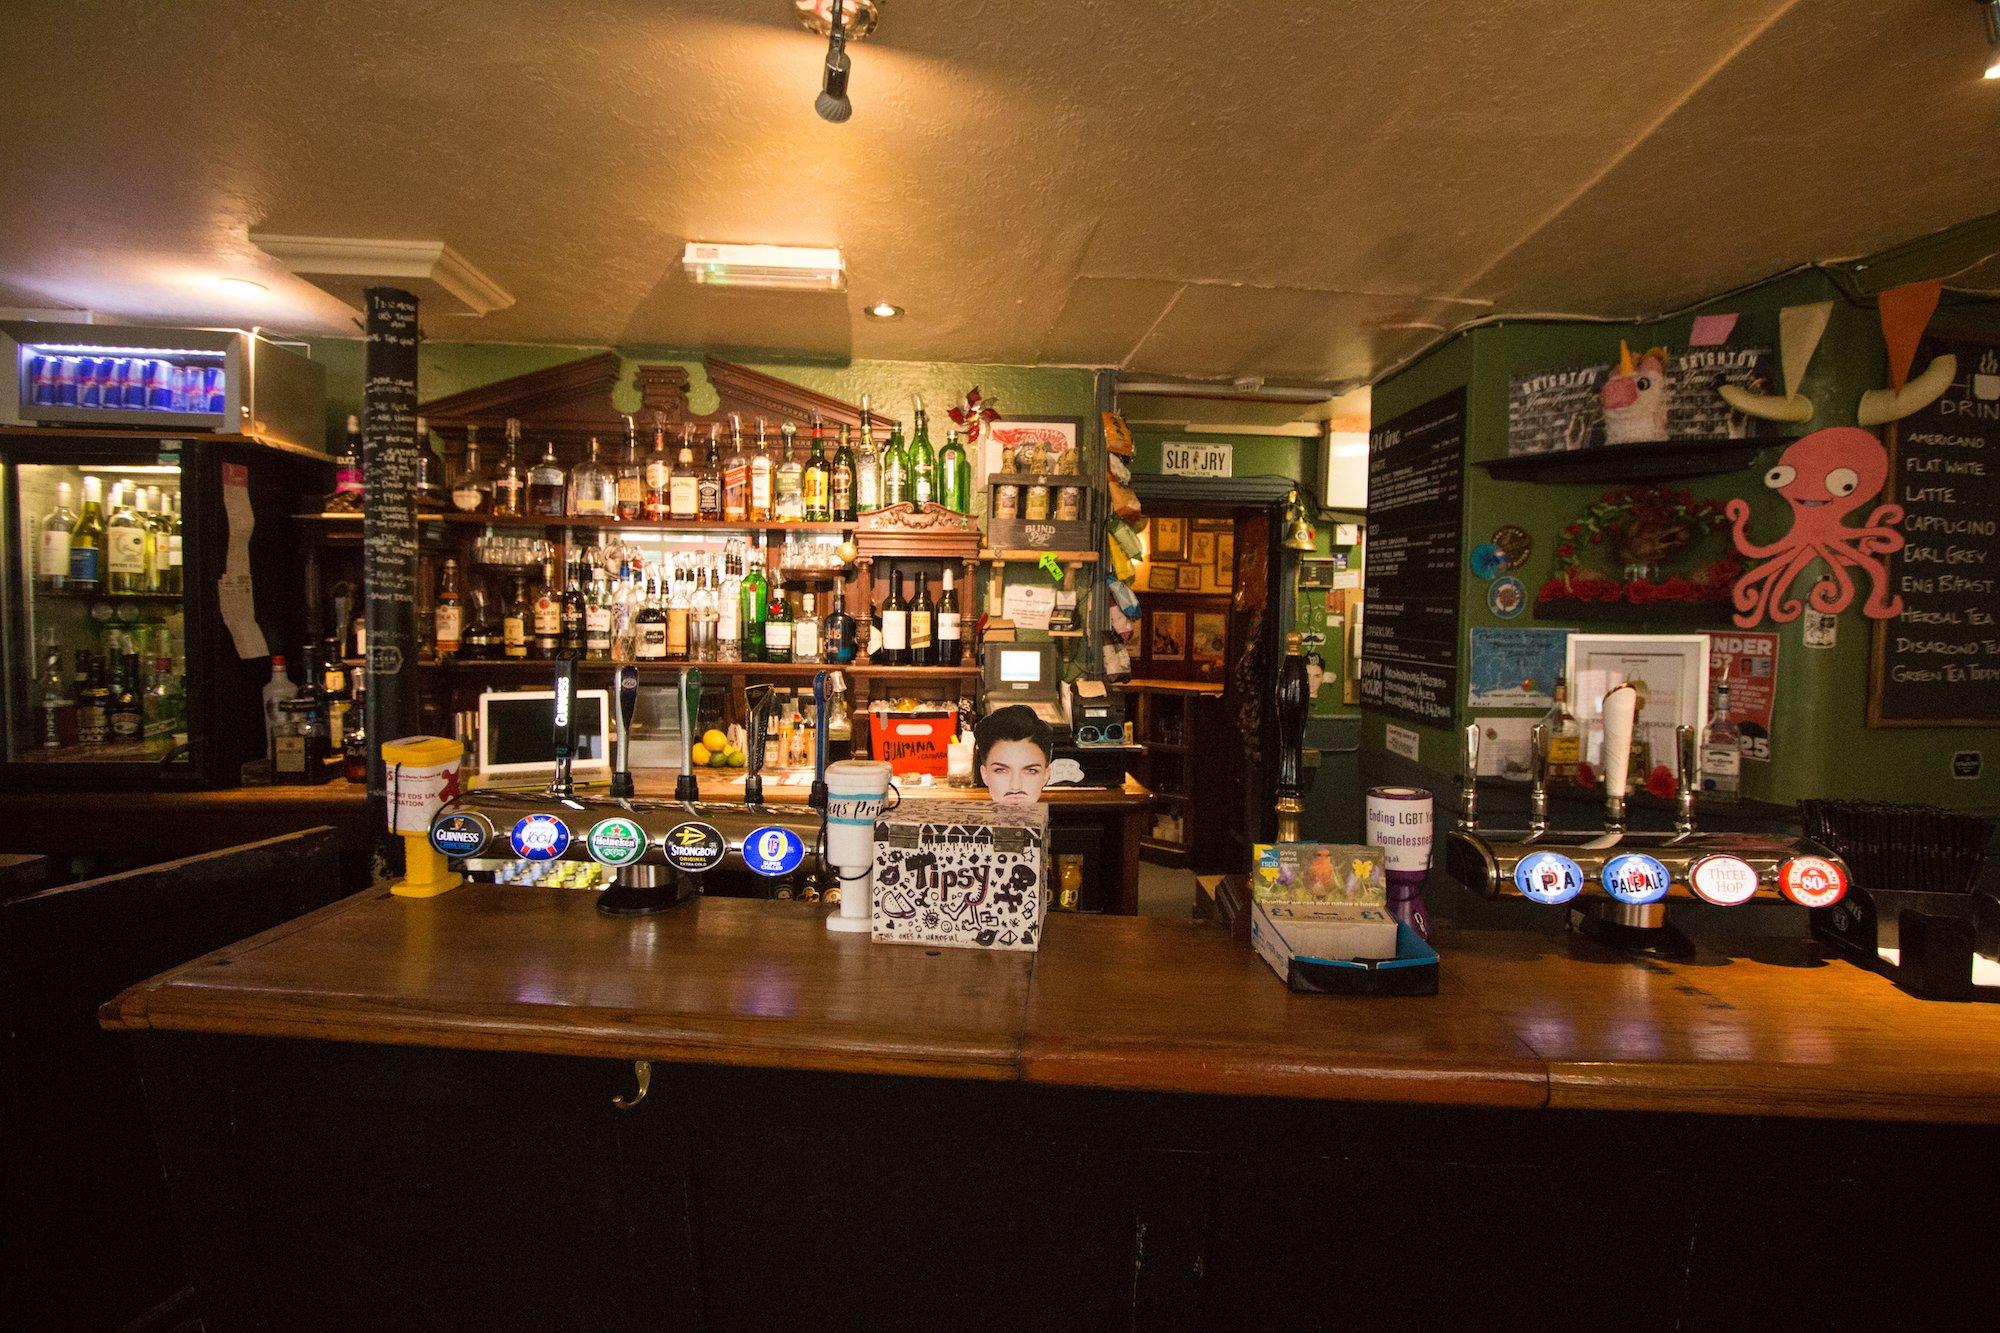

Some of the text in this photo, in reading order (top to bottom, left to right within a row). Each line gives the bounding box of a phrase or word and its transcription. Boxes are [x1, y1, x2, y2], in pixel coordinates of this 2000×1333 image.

[1679, 352, 1758, 370] BRIGHTON
[1522, 371, 1598, 395] BRIGHTON
[1940, 400, 2000, 420] DRIN
[1908, 432, 1985, 449] AMERICANO
[1166, 450, 1225, 470] SLR JRY
[1906, 457, 1986, 476] FLAT WHITE
[1904, 485, 1957, 503] LATTE
[1904, 514, 1997, 536] CAPPUCINO
[1903, 543, 1988, 564] EARL GREY
[1901, 576, 1934, 593] ENG
[1900, 606, 1995, 625] HERBAL TEA
[1712, 637, 1773, 656] NDER
[1890, 664, 1943, 683] GREEN
[1942, 663, 1966, 682] TEA
[1740, 738, 1769, 758] 25
[1369, 808, 1395, 826] Ending
[1399, 812, 1423, 825] LGBT
[436, 829, 479, 843] GUINNESS
[525, 831, 554, 844] 1664
[595, 836, 636, 848] Heineken
[670, 846, 718, 857] STRONGBOW
[1261, 860, 1279, 868] rspb
[905, 850, 990, 905] Tipsy
[1611, 872, 1664, 894] PALE ALE
[1272, 907, 1293, 918] £1
